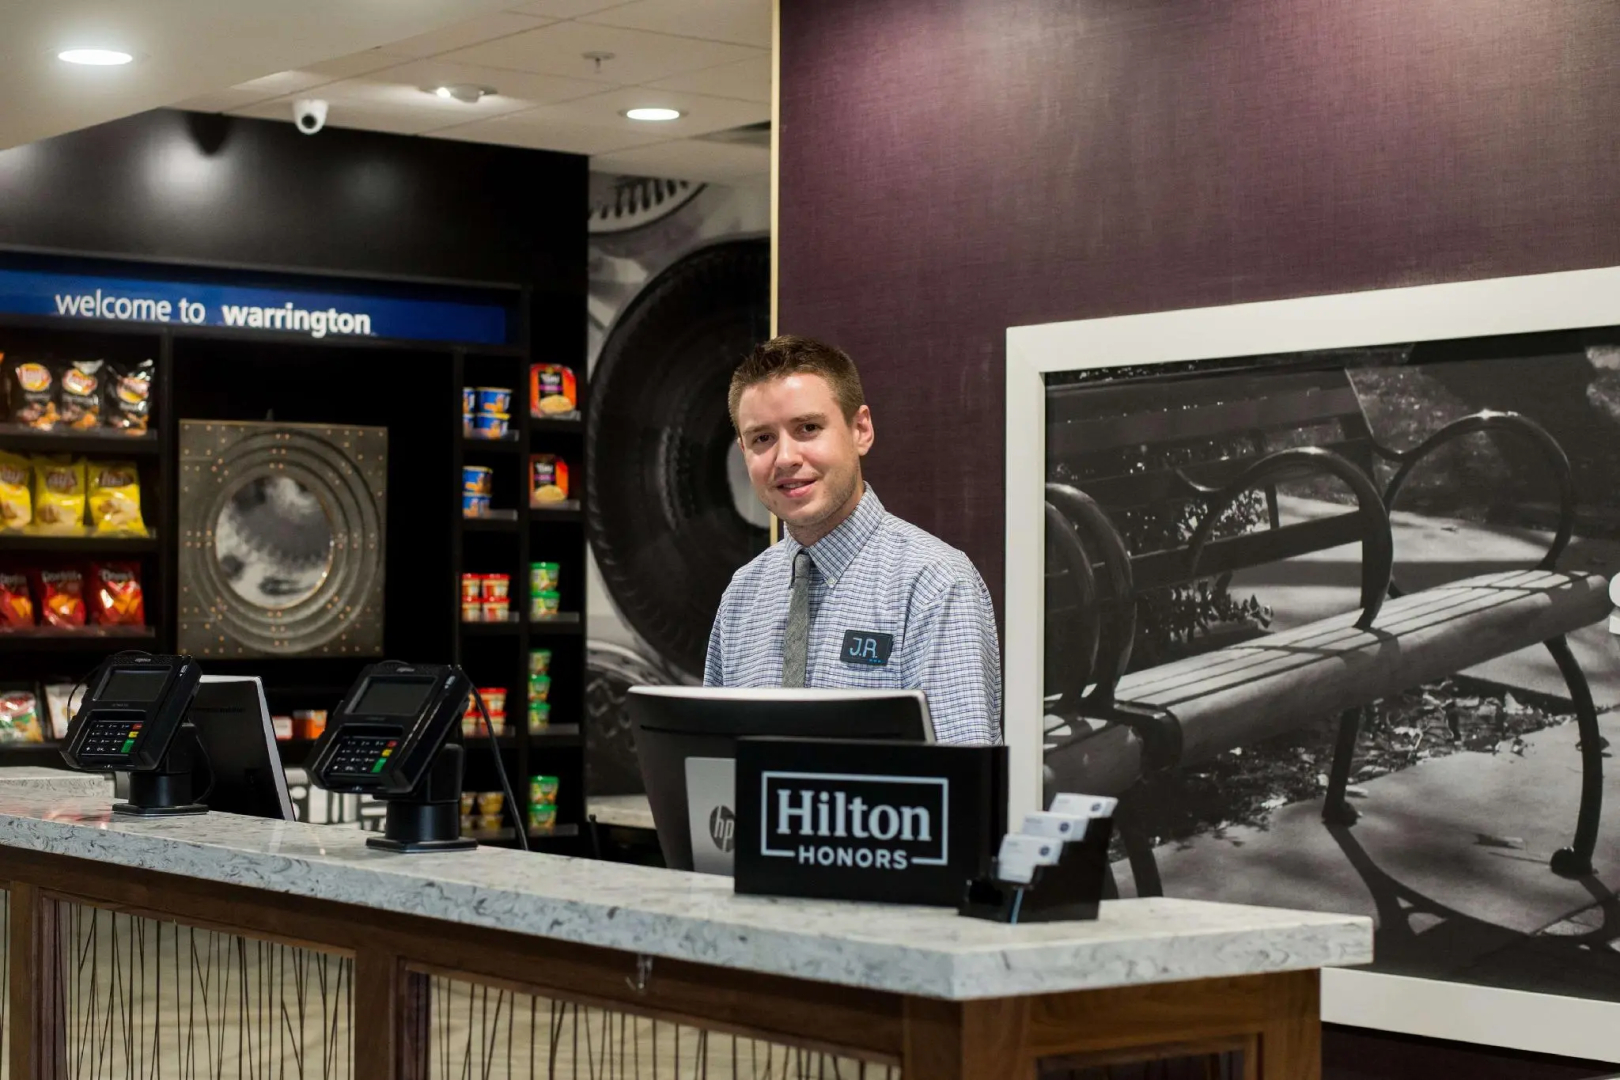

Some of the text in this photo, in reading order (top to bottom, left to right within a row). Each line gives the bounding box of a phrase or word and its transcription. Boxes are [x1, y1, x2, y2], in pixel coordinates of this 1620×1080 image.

[55, 289, 372, 339] welcome to warrington
[714, 805, 735, 853] hp
[776, 788, 932, 842] Hilton
[798, 845, 908, 870] HONORS
